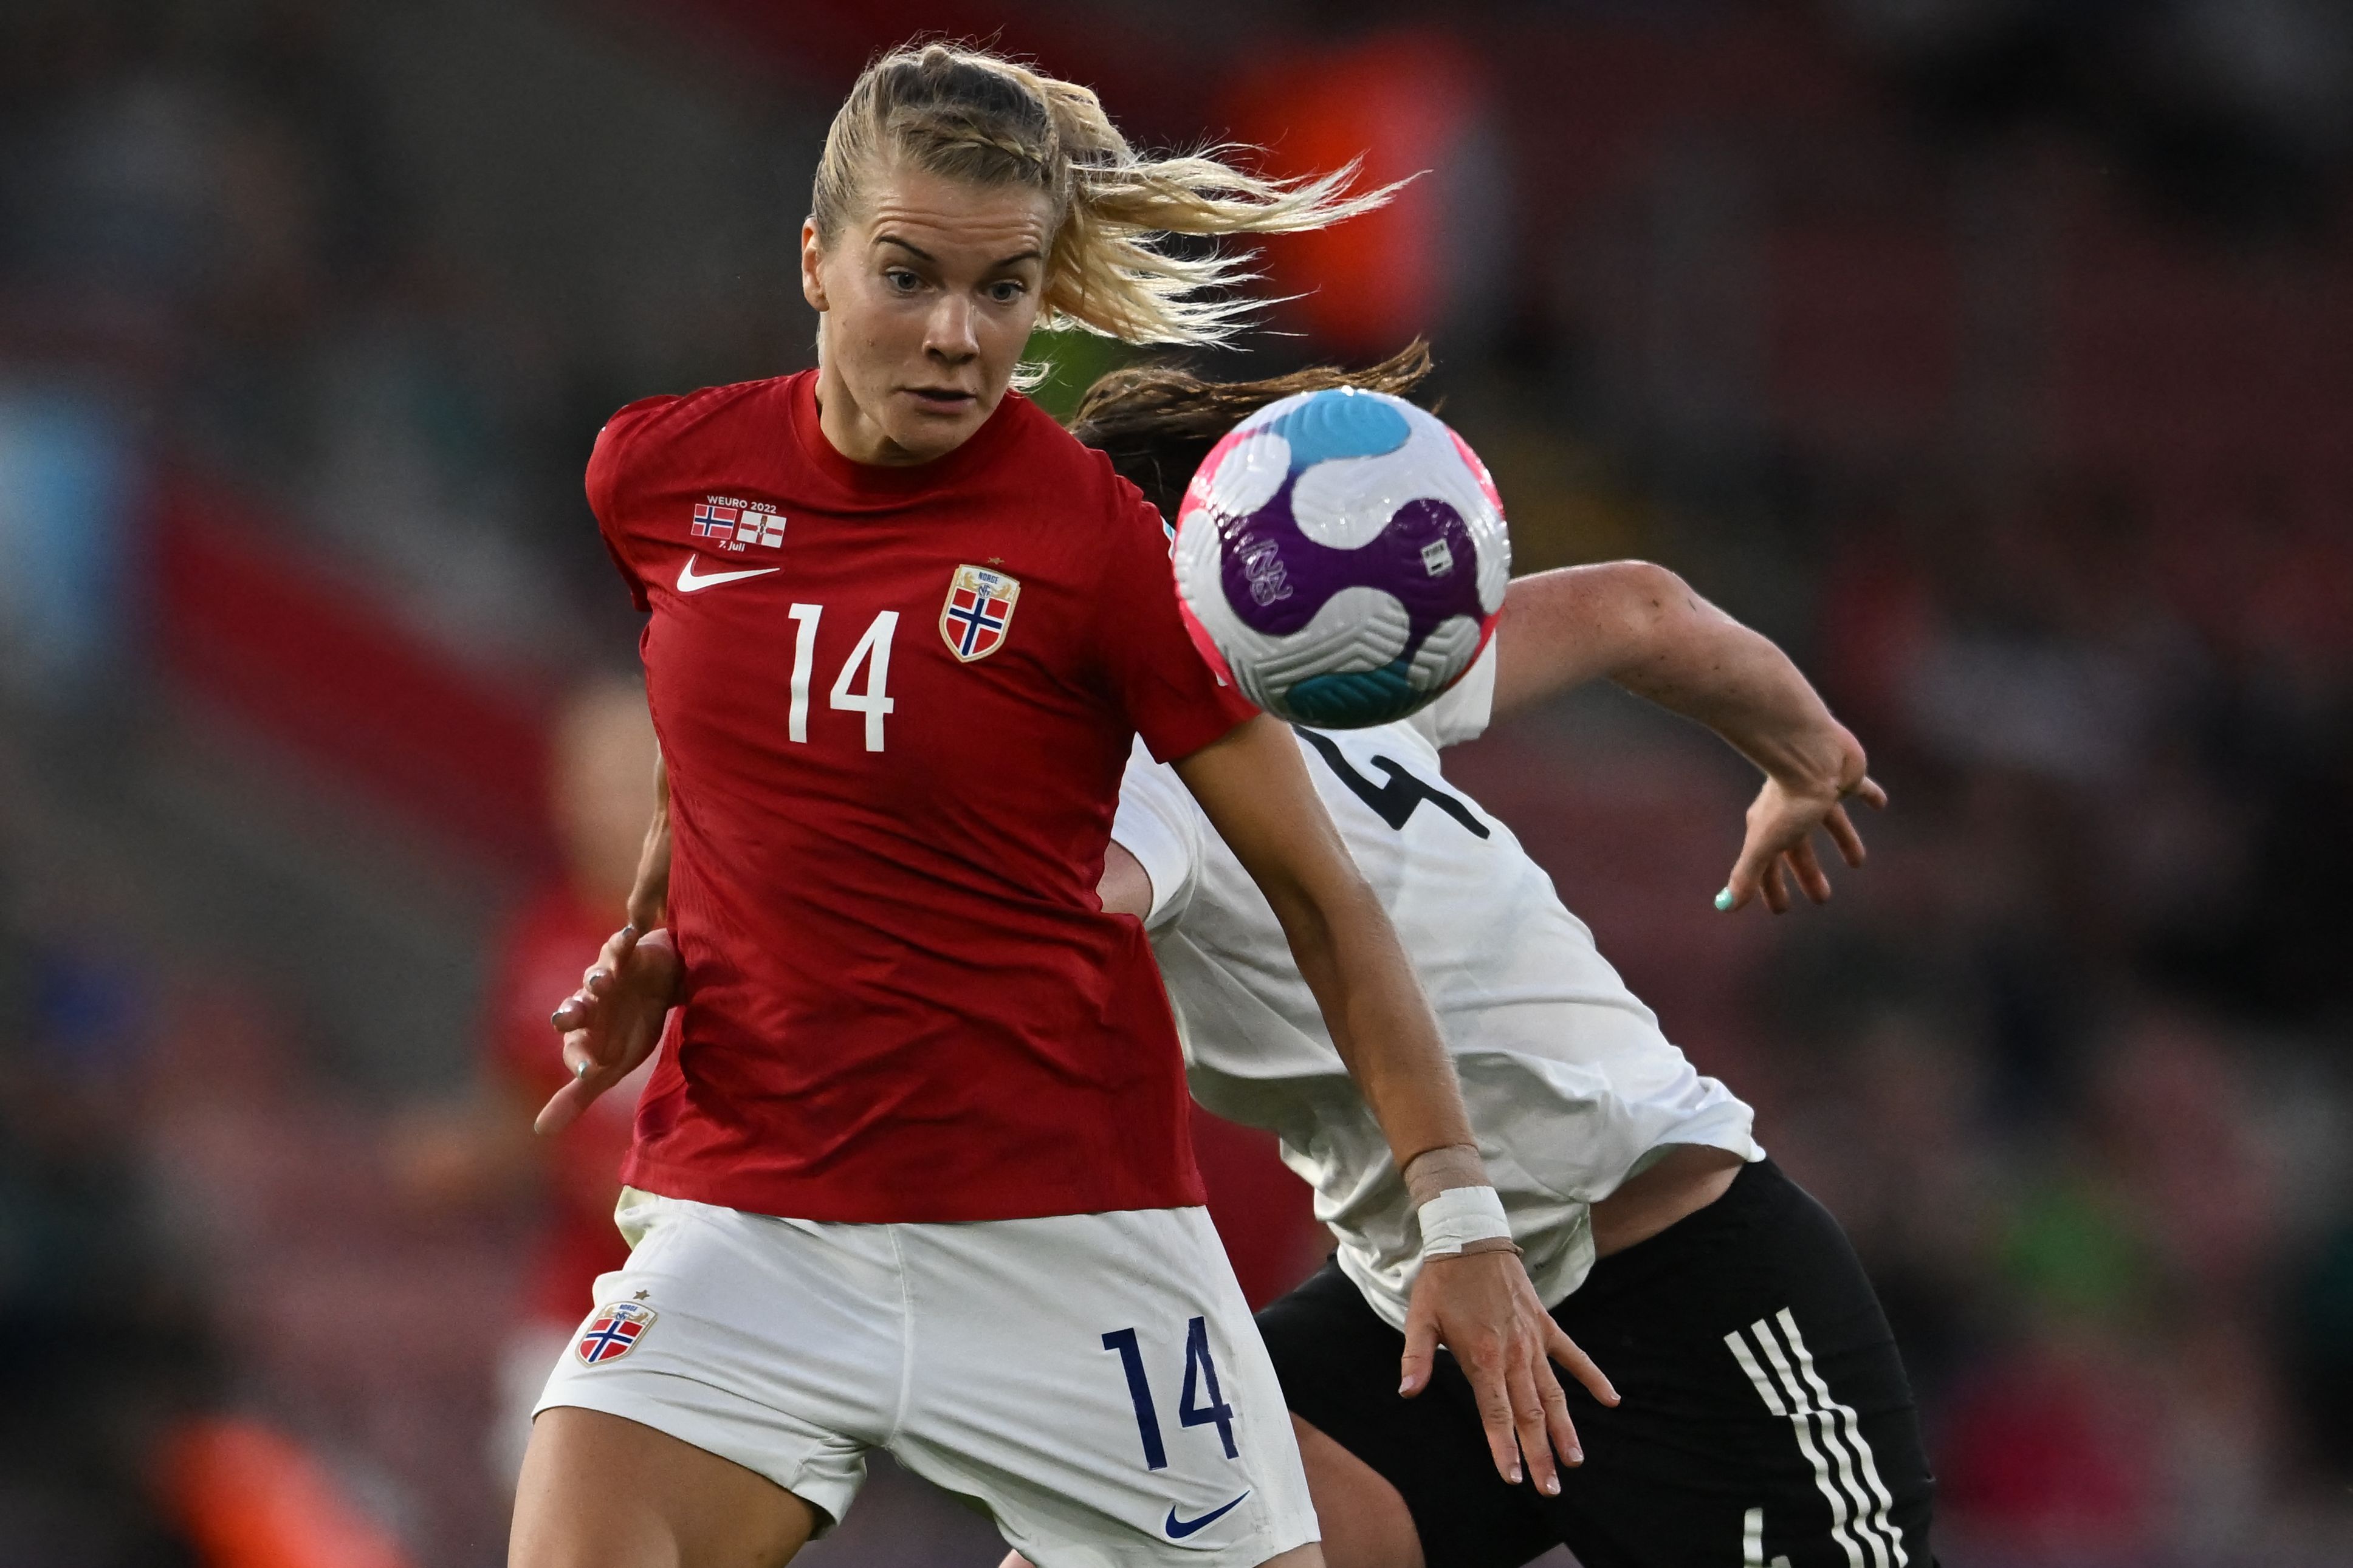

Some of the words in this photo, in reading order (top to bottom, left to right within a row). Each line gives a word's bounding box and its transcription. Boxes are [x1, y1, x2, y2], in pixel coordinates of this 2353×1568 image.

[707, 495, 747, 508] WEURO
[751, 502, 777, 514] 2022
[718, 540, 726, 549] 7.
[978, 572, 998, 584] NORGE
[788, 603, 899, 752] 14
[1291, 722, 1491, 840] 4
[1101, 1315, 1240, 1471] 14
